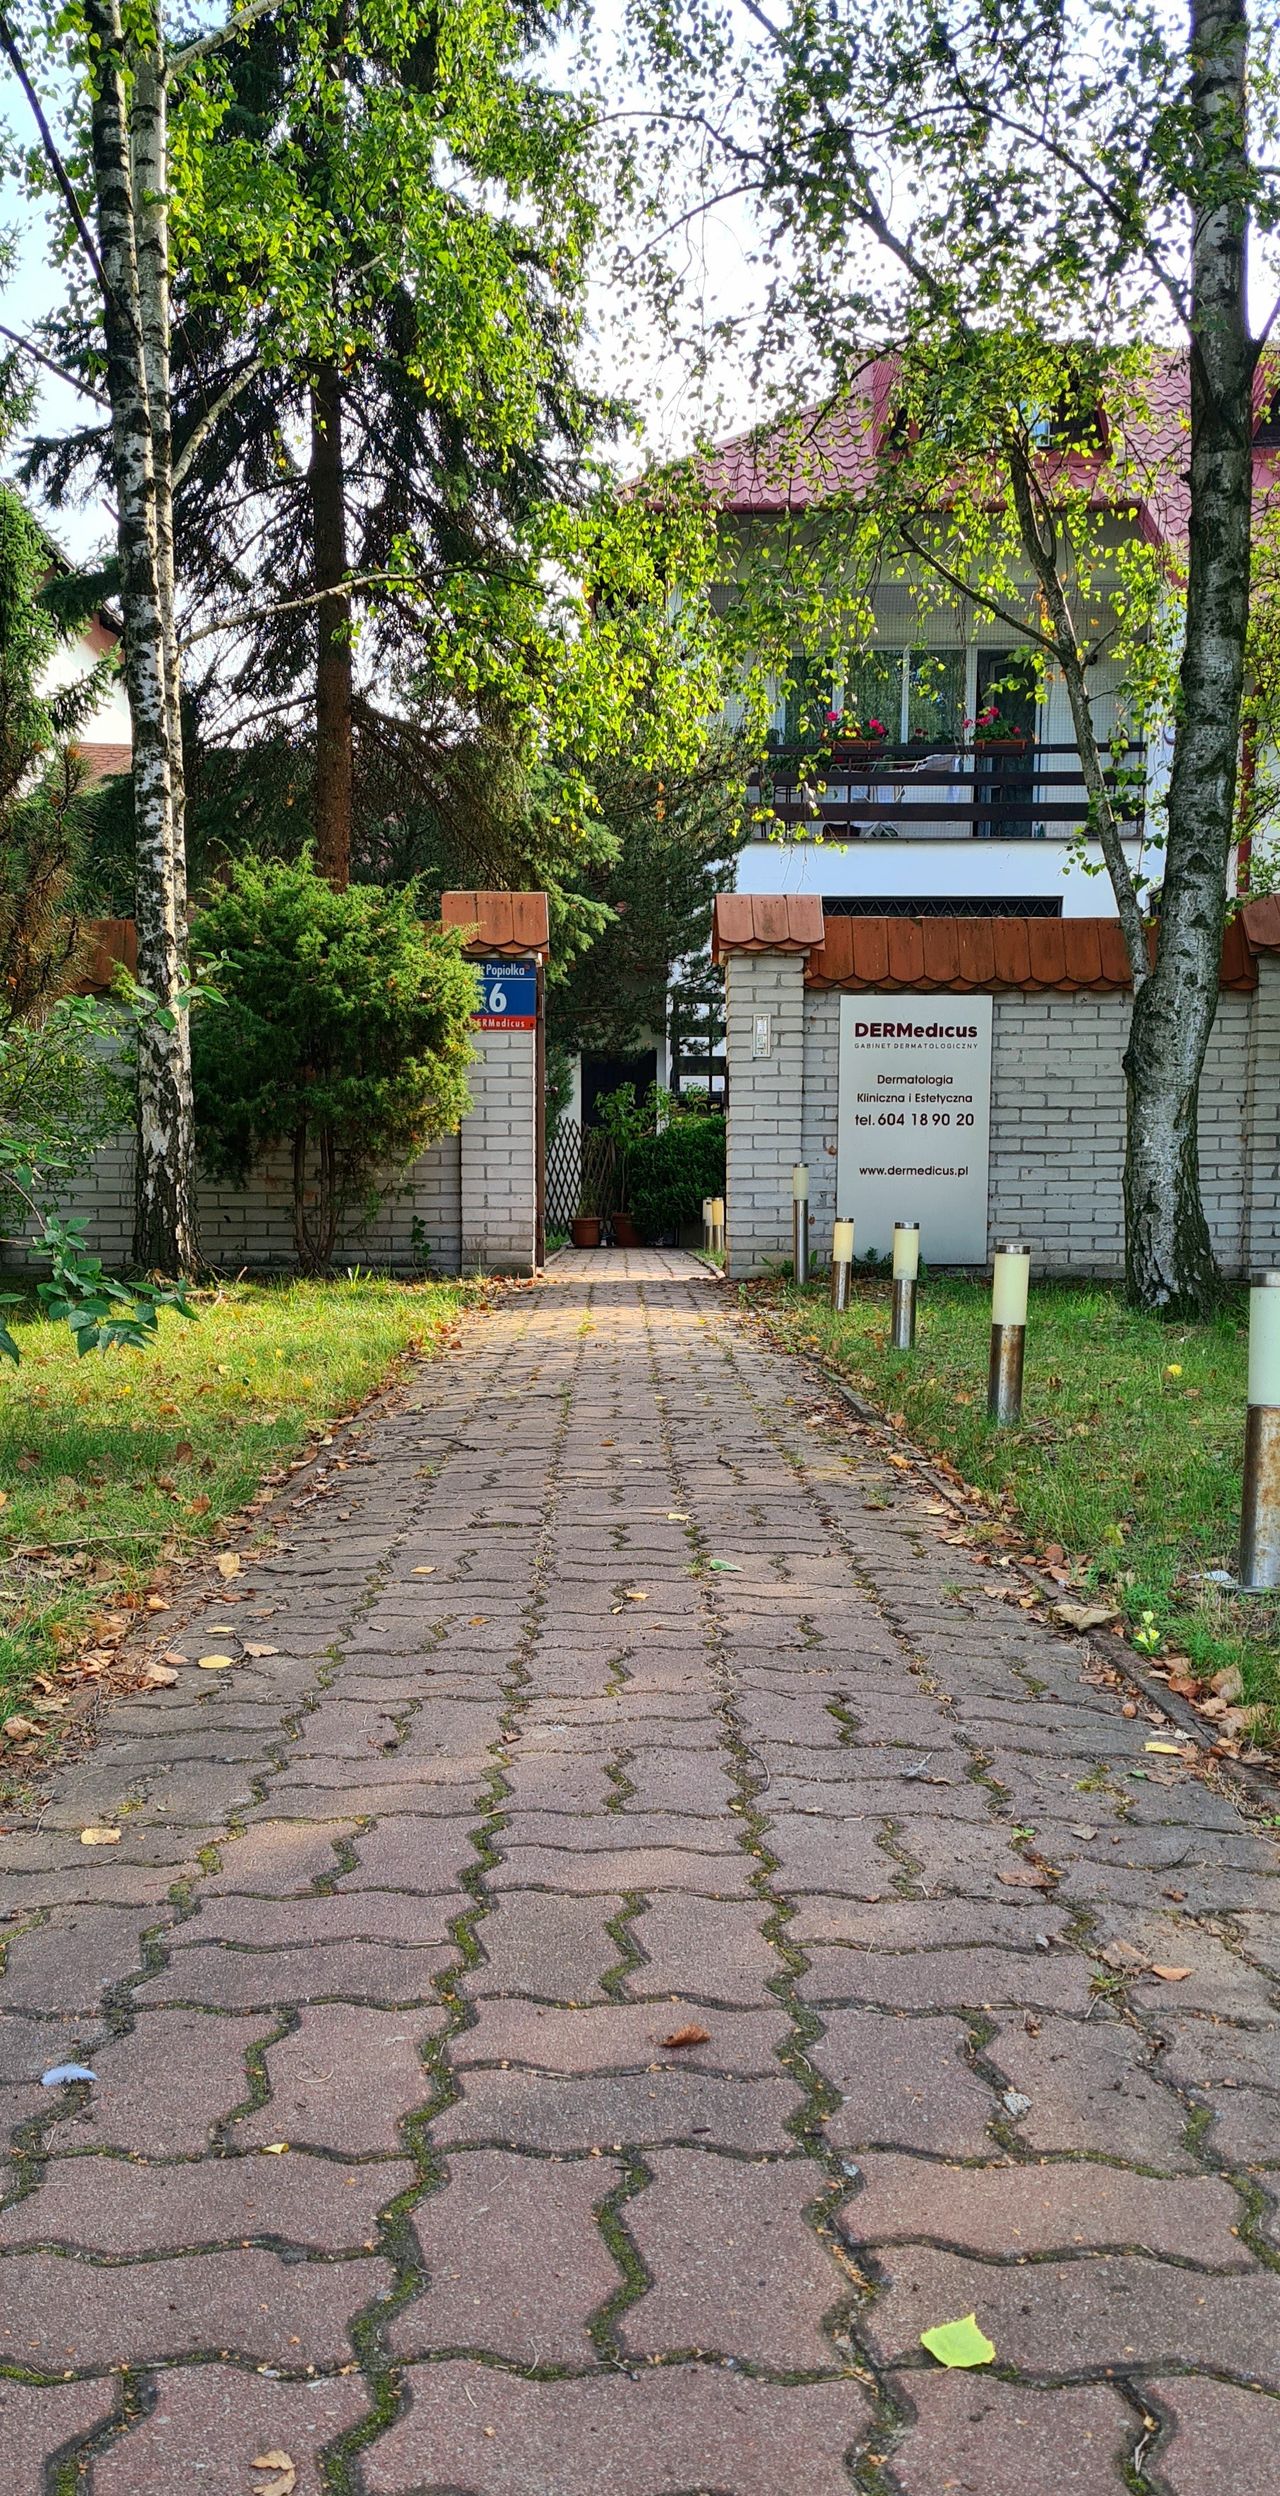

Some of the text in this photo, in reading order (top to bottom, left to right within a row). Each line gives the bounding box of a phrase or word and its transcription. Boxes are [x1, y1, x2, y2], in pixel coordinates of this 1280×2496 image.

[486, 963, 525, 977] Popiołka
[489, 983, 507, 1012] 6
[855, 1023, 978, 1038] DERMedicus
[877, 1075, 953, 1087] Dermatologia
[857, 1093, 973, 1104] Kliniczna i Estetyczna
[854, 1112, 975, 1126] tel. 604 18 90 20
[859, 1165, 969, 1178] www.dermedicus.pl
